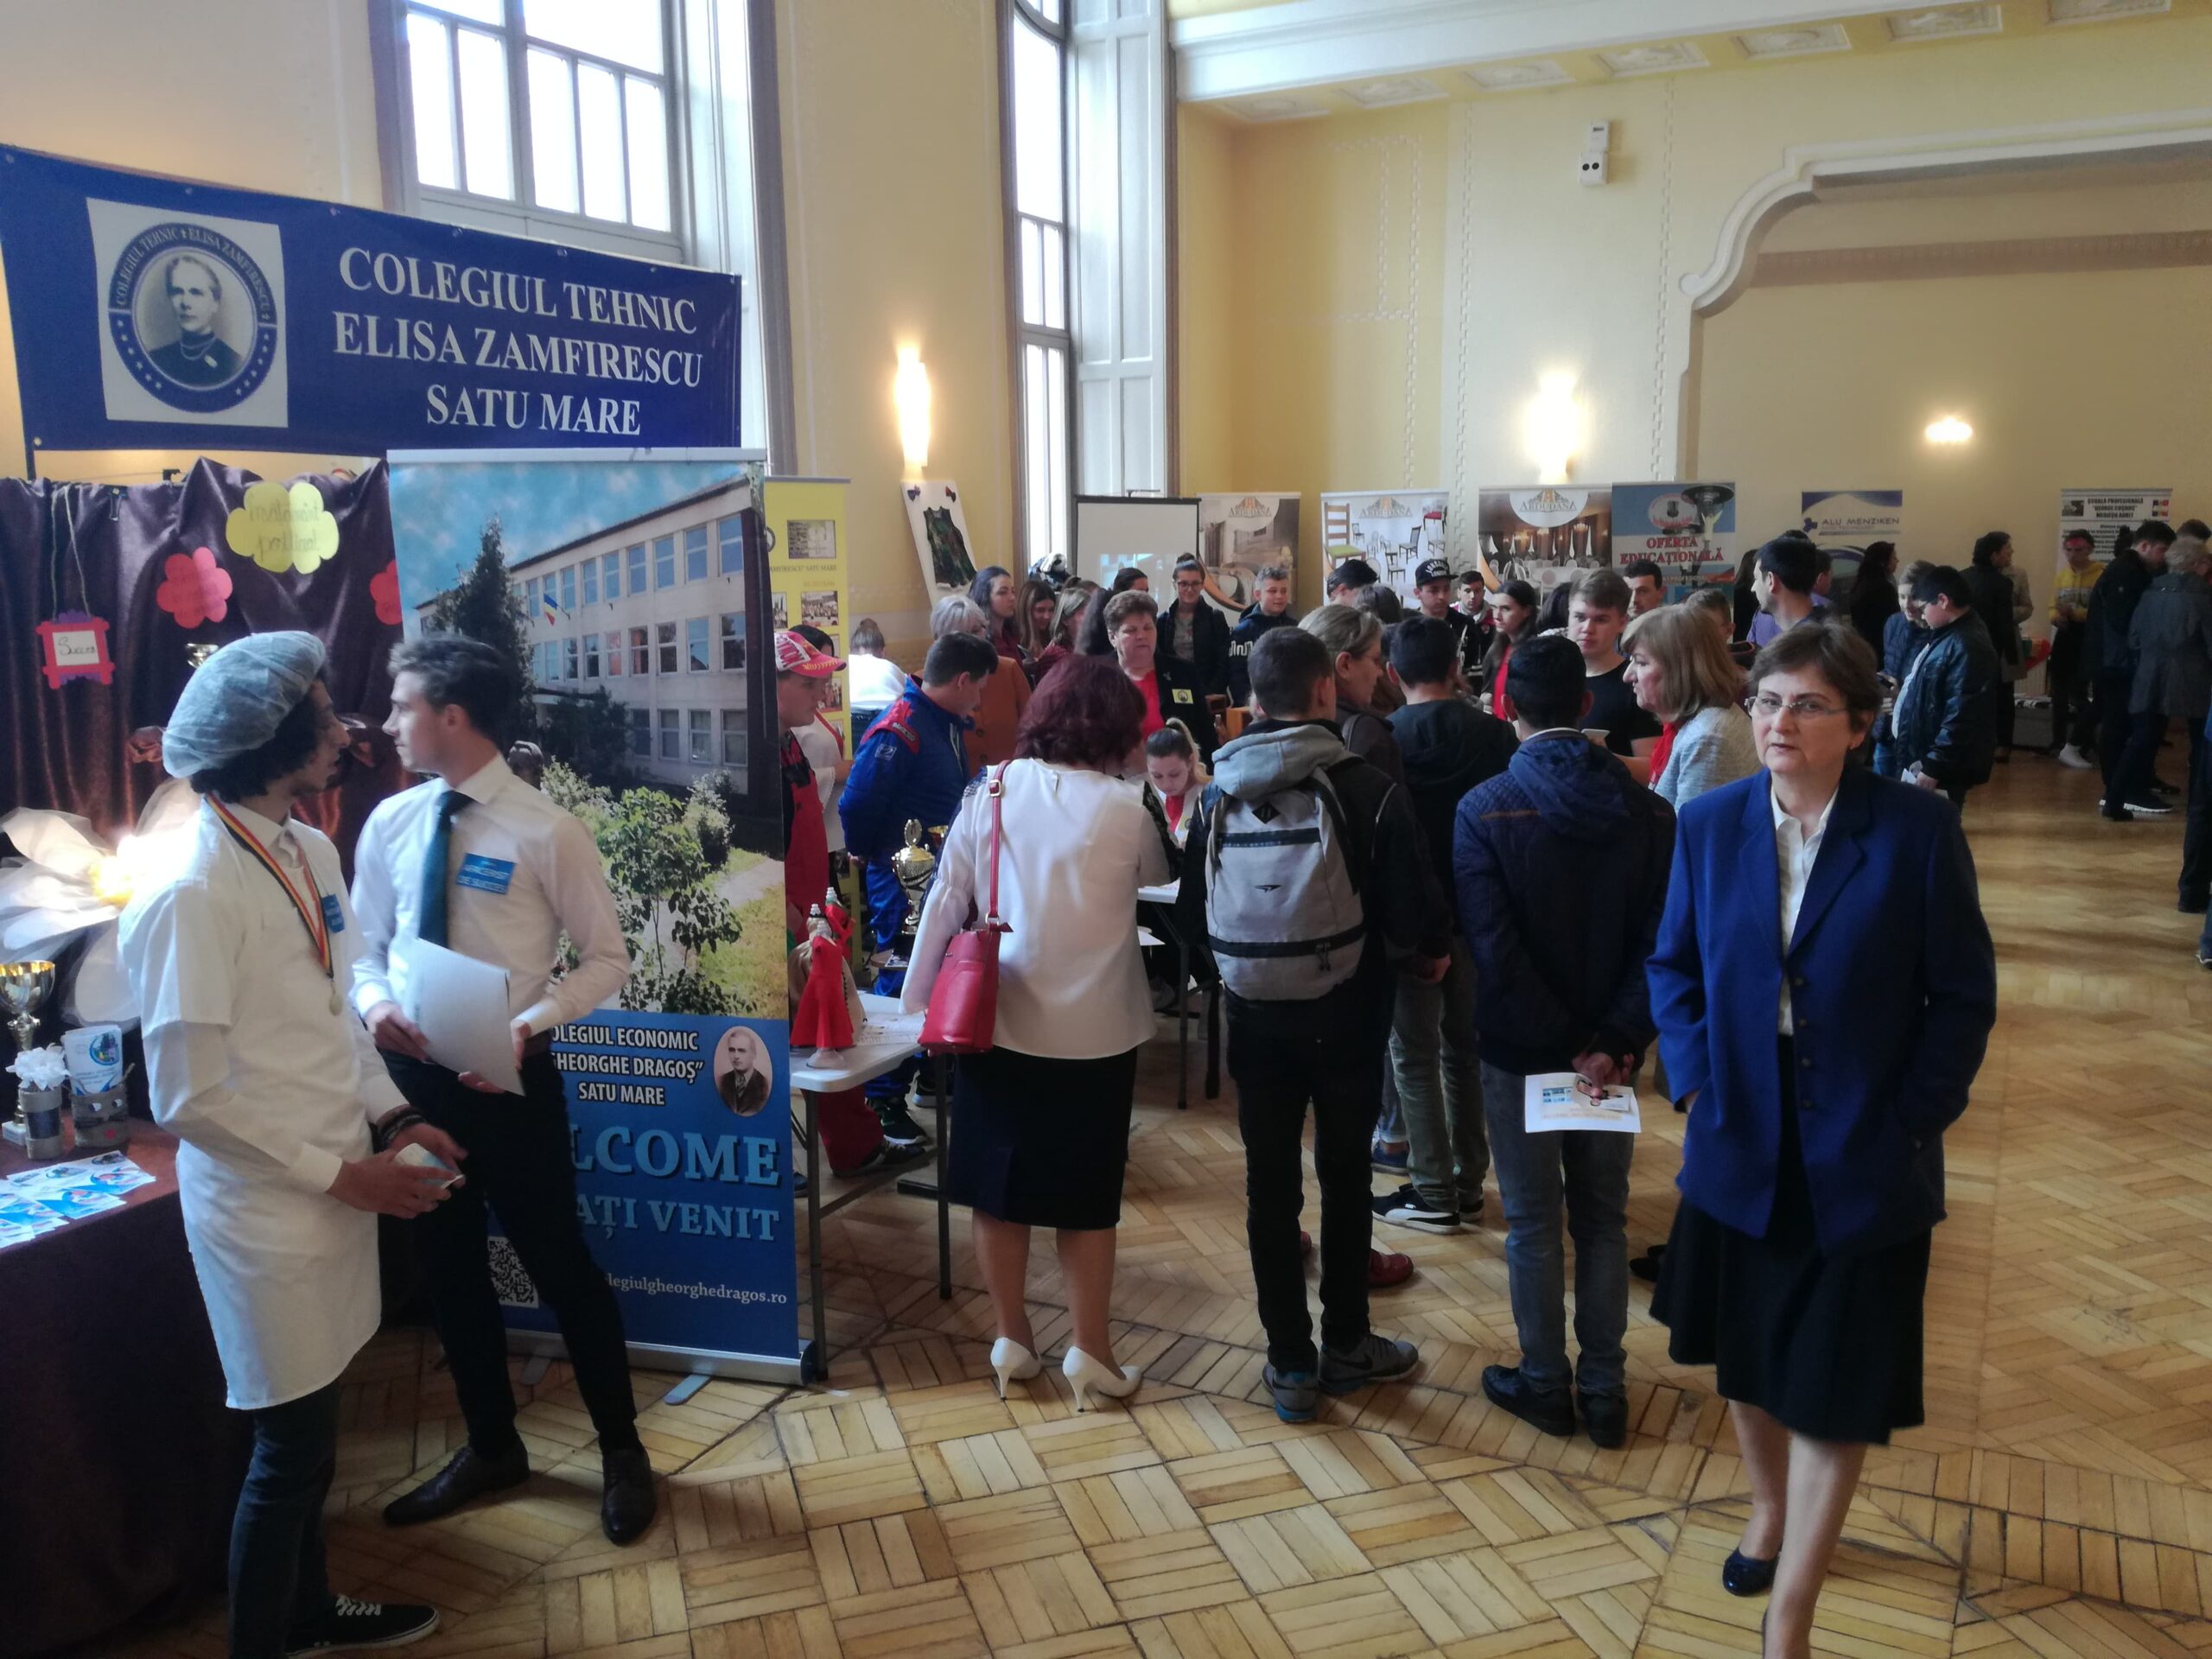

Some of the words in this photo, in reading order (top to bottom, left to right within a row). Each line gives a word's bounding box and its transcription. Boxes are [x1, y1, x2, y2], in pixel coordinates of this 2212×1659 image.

[115, 245, 145, 305] COLEGIUL
[139, 227, 178, 251] TEHNIC
[188, 227, 220, 249] ELISA
[339, 246, 557, 317] COLEGIUL
[563, 282, 697, 334] TEHNIC
[333, 311, 467, 365] ELISA
[474, 327, 703, 387] ZAMFIRESCU
[427, 384, 530, 429] SATU
[539, 392, 640, 435] MARE
[1646, 537, 1698, 550] OFERTA
[552, 1025, 613, 1045] OLEGIUL
[617, 1028, 698, 1051] ECONOMIC
[553, 1052, 630, 1074] HEORGHE
[578, 1083, 616, 1102] SATU
[620, 1085, 664, 1105] MARE
[569, 1123, 779, 1186] LCOME
[648, 1200, 779, 1241] VENIT
[606, 1273, 787, 1304] legiulgheorghedragos.ro
